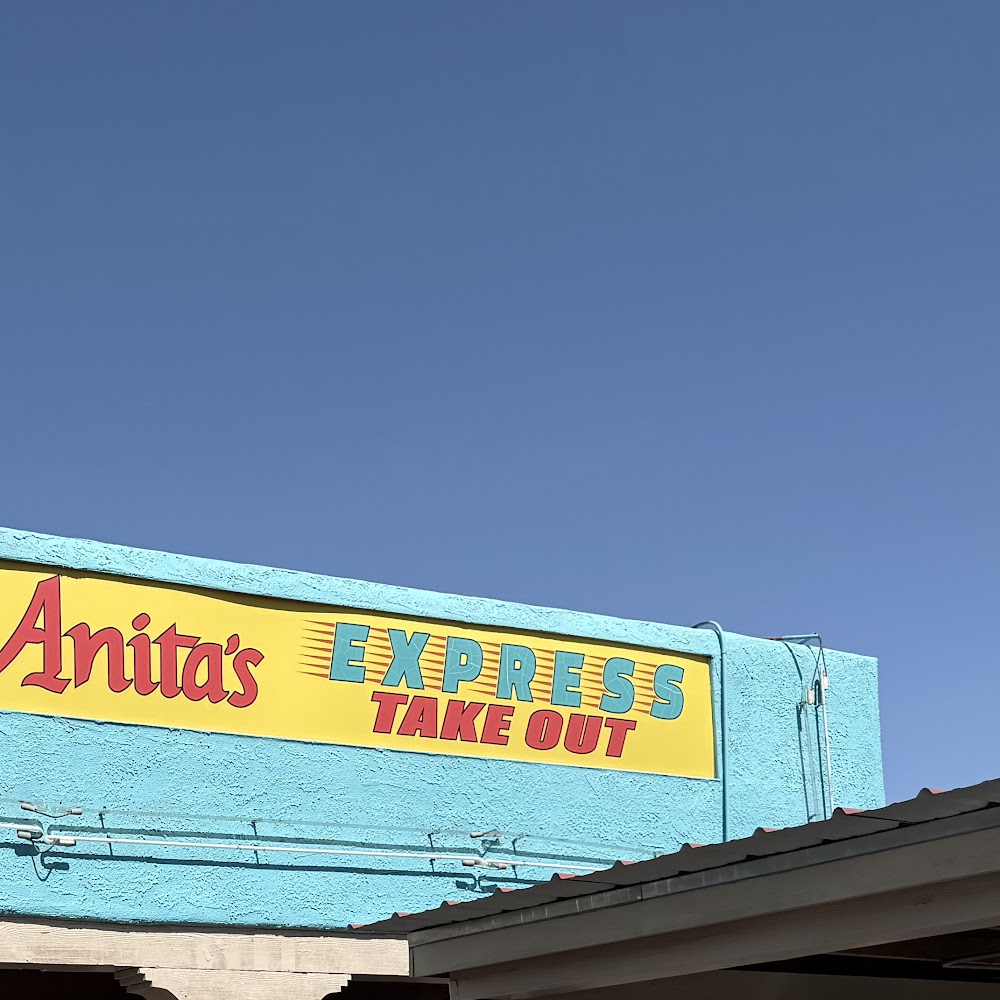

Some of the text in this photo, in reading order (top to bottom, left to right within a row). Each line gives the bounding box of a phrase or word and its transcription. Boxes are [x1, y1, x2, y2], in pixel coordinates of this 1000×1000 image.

[329, 622, 685, 721] EXPRESS
[371, 691, 637, 758] TAKE OUT
